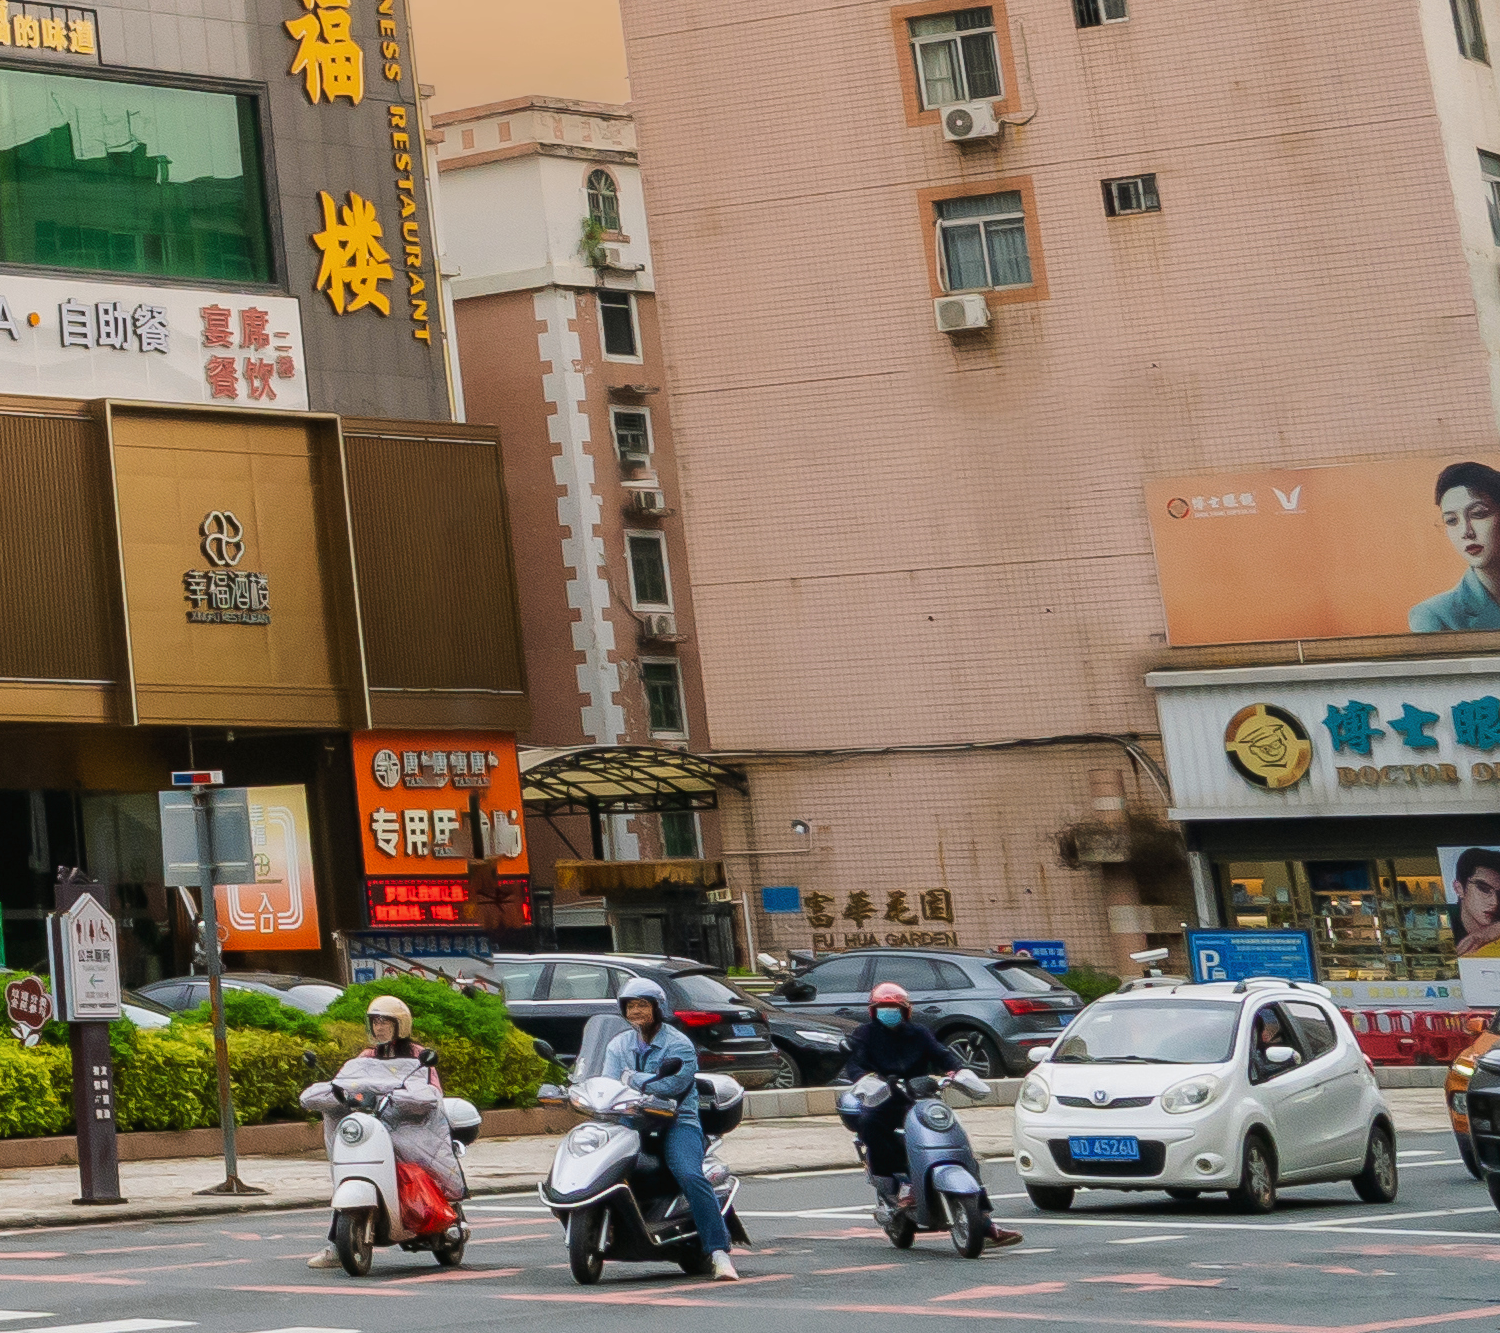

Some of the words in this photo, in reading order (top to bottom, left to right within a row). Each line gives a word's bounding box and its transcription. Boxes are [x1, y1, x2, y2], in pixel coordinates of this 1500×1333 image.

[388, 104, 432, 347] RESTAURANT
[58, 298, 172, 355] 自助餐
[186, 569, 272, 611] 幸福酒楼
[258, 892, 274, 934] 入口
[812, 932, 835, 947] FU
[844, 932, 880, 947] HUA
[885, 932, 958, 947] GARDEN
